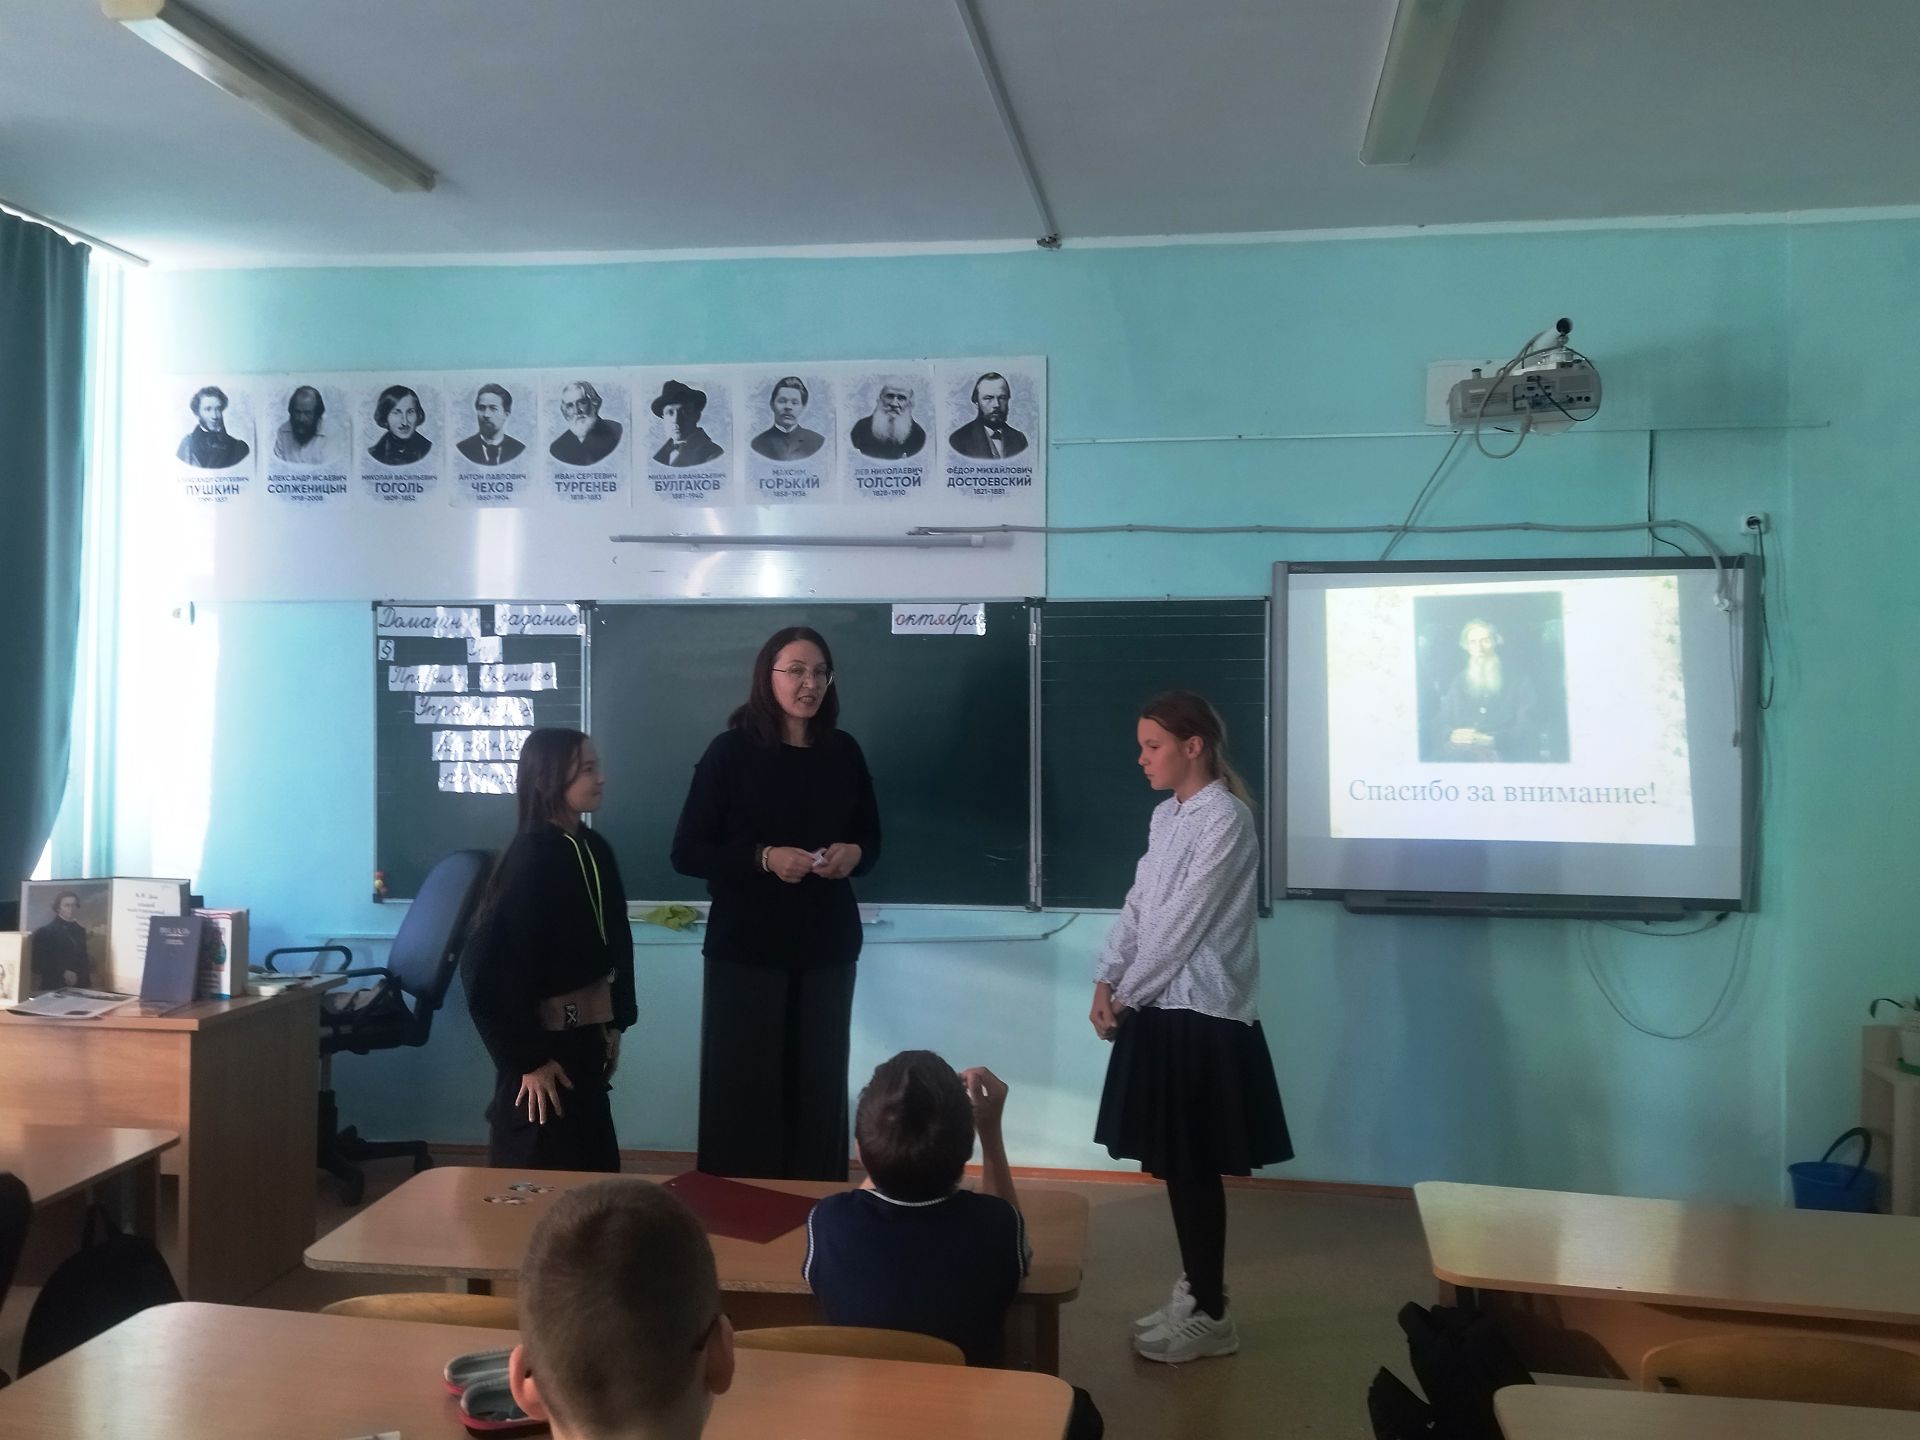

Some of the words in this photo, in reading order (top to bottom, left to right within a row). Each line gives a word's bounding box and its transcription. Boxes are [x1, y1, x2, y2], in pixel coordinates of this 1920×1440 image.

[870, 467, 923, 475] НИКОЛАЕВИЧ
[946, 466, 975, 475] ФЁДОР
[976, 465, 1033, 474] МИХАЙЛОВИЧ
[576, 472, 617, 480] СЕРГЕЕВИЧ
[759, 474, 820, 489] ГОРЬКИЙ
[856, 473, 922, 489] ТОЛСТОЙ
[946, 474, 1032, 488] ДОСТОЕВСКИЙ
[186, 484, 240, 495] ПУШКИН
[267, 484, 347, 494] СОЛЖЕНИЦЫН
[375, 482, 424, 493] ГОГОЛЬ
[471, 481, 514, 493] ЧЕХОВ
[555, 481, 617, 492] ТУРГЕНЕВ
[654, 480, 721, 492] БУЛГАКОВ
[1349, 779, 1460, 801] Спасибо
[1467, 785, 1495, 802] за
[1504, 782, 1658, 805] внимание!
